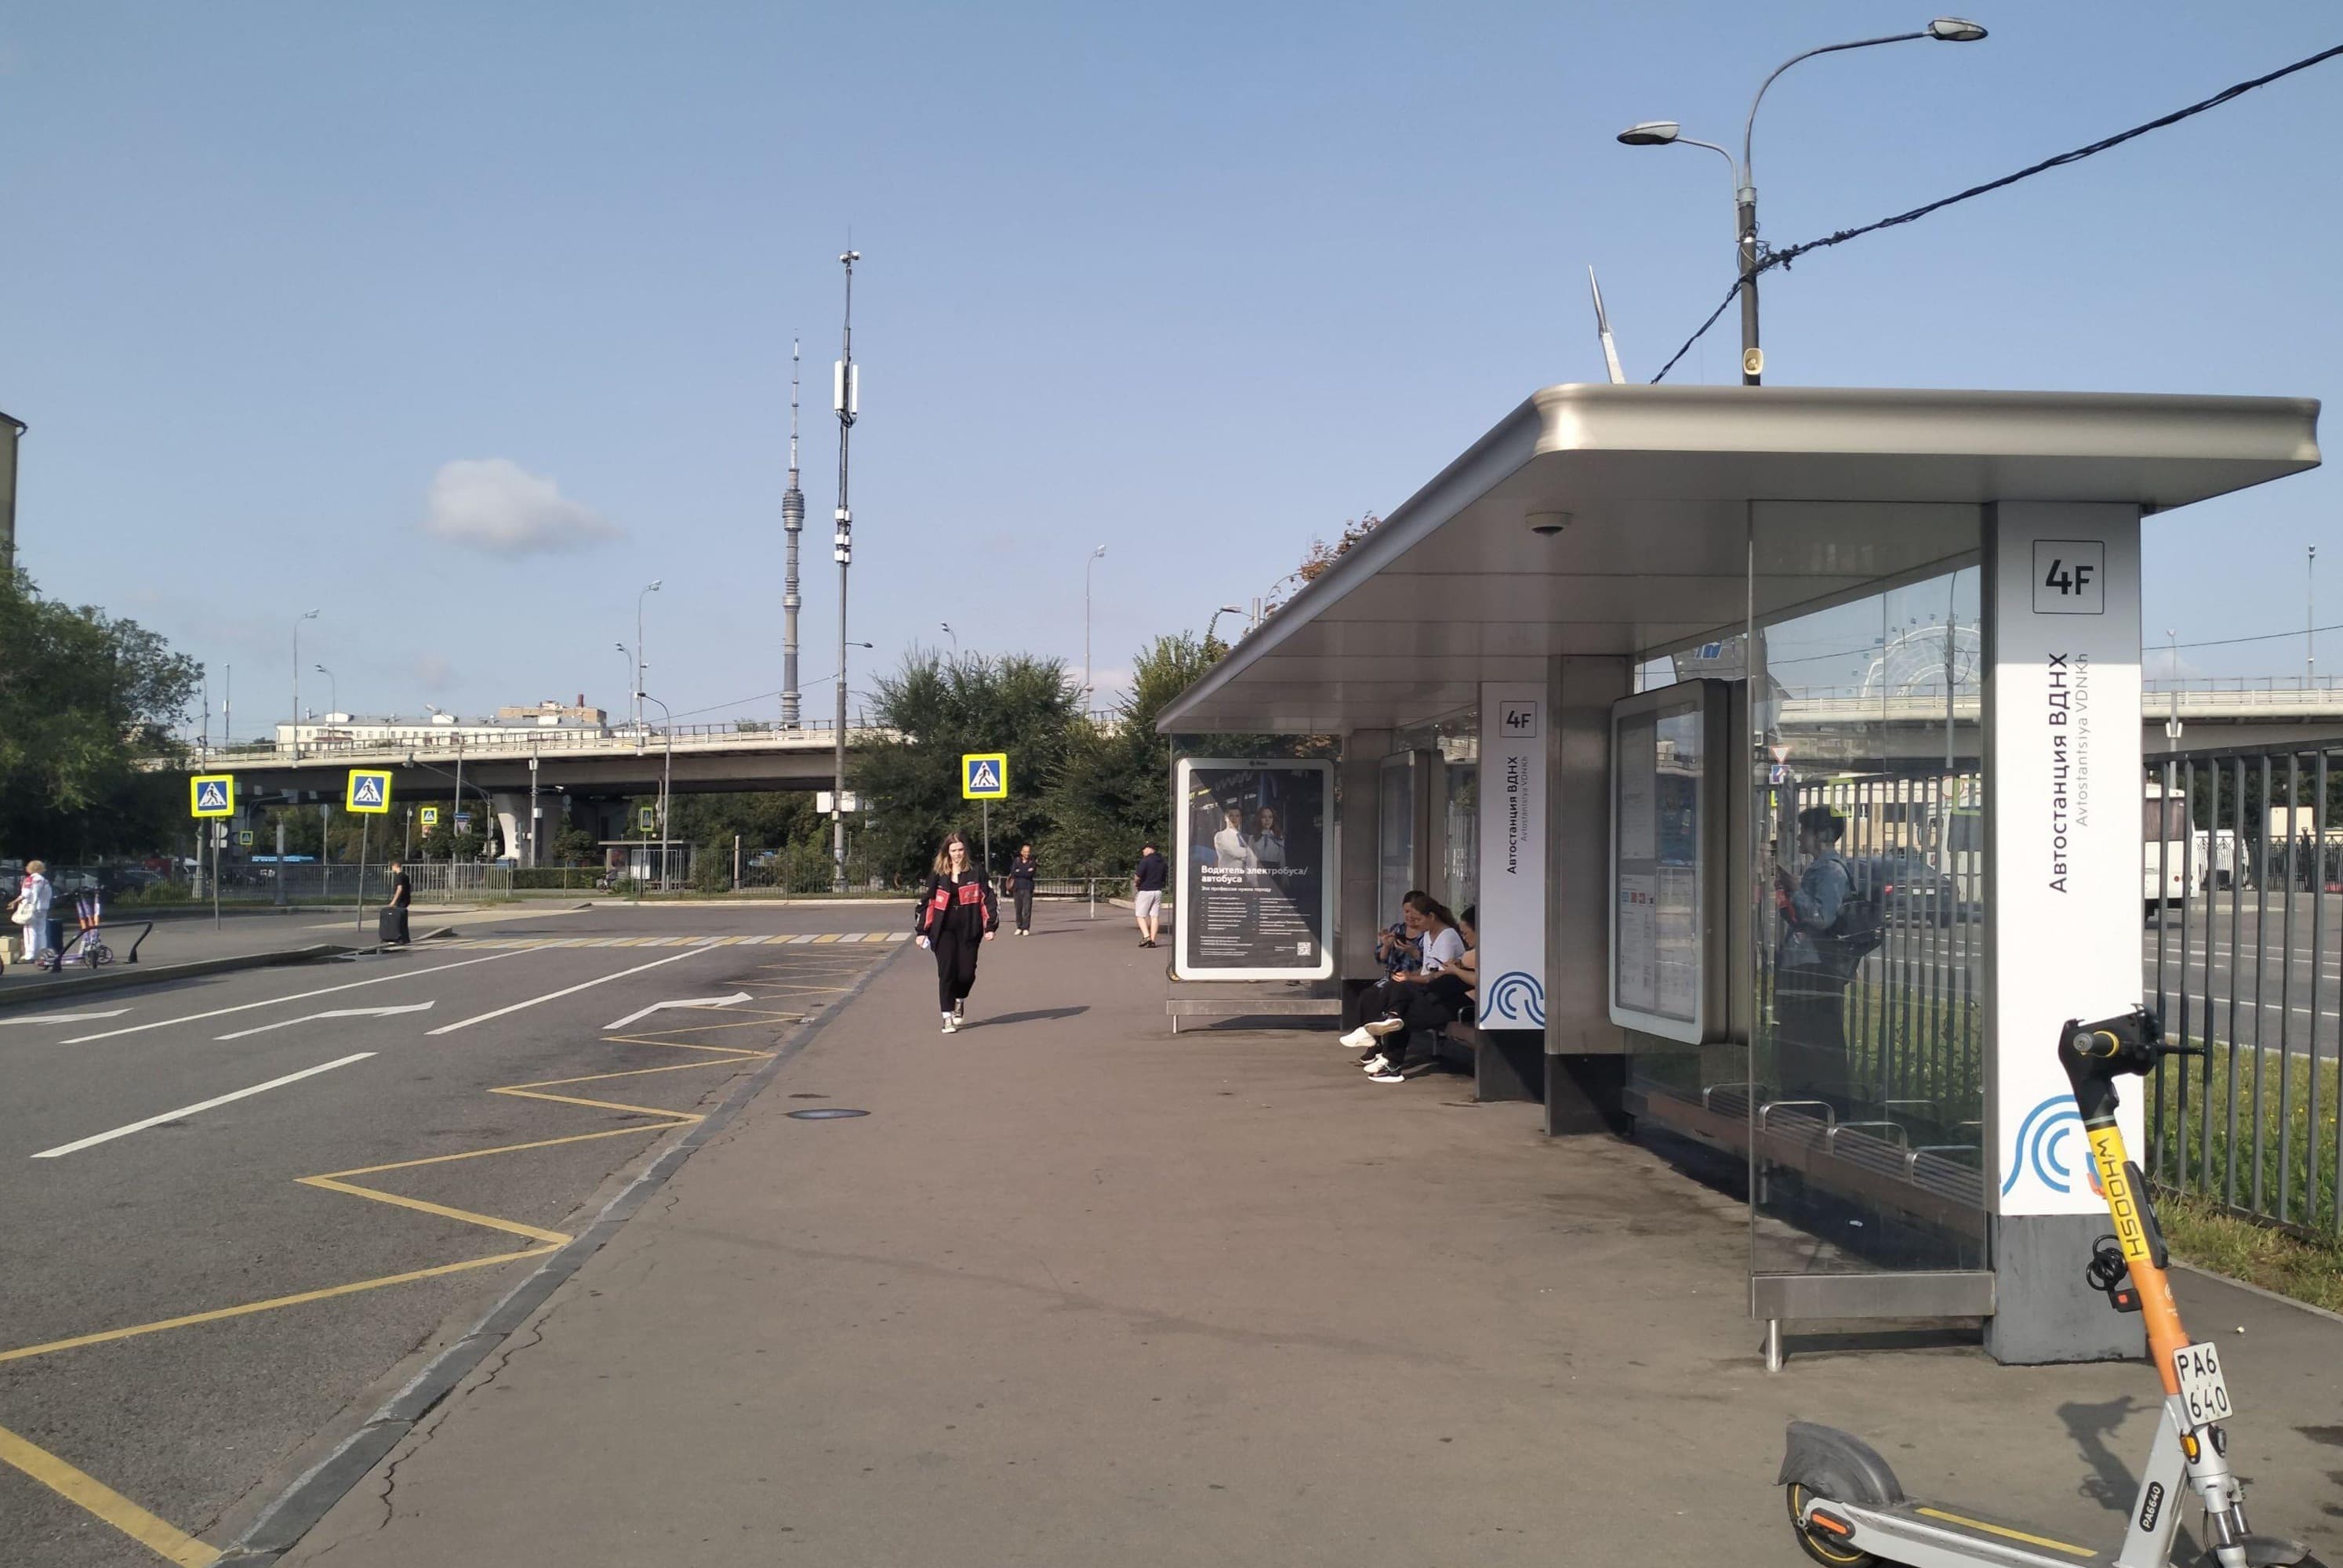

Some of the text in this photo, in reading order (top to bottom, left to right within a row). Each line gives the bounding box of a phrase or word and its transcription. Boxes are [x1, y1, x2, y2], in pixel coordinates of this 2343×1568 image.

[2045, 559, 2094, 595] 4F
[1506, 710, 1531, 729] 4F
[2075, 653, 2091, 827] Avtostantsiya VDNKh
[2049, 652, 2071, 894] Автостанция ВДНХ
[1506, 756, 1519, 875] Автостанция ВДНХ
[1201, 866, 1308, 876] Водитель электробуса/
[1201, 875, 1242, 884] автобуса
[2096, 1137, 2145, 1257] WHOOSH
[2177, 1348, 2217, 1381] PA6
[2189, 1386, 2228, 1418] 640
[2142, 1486, 2161, 1529] PA6640
